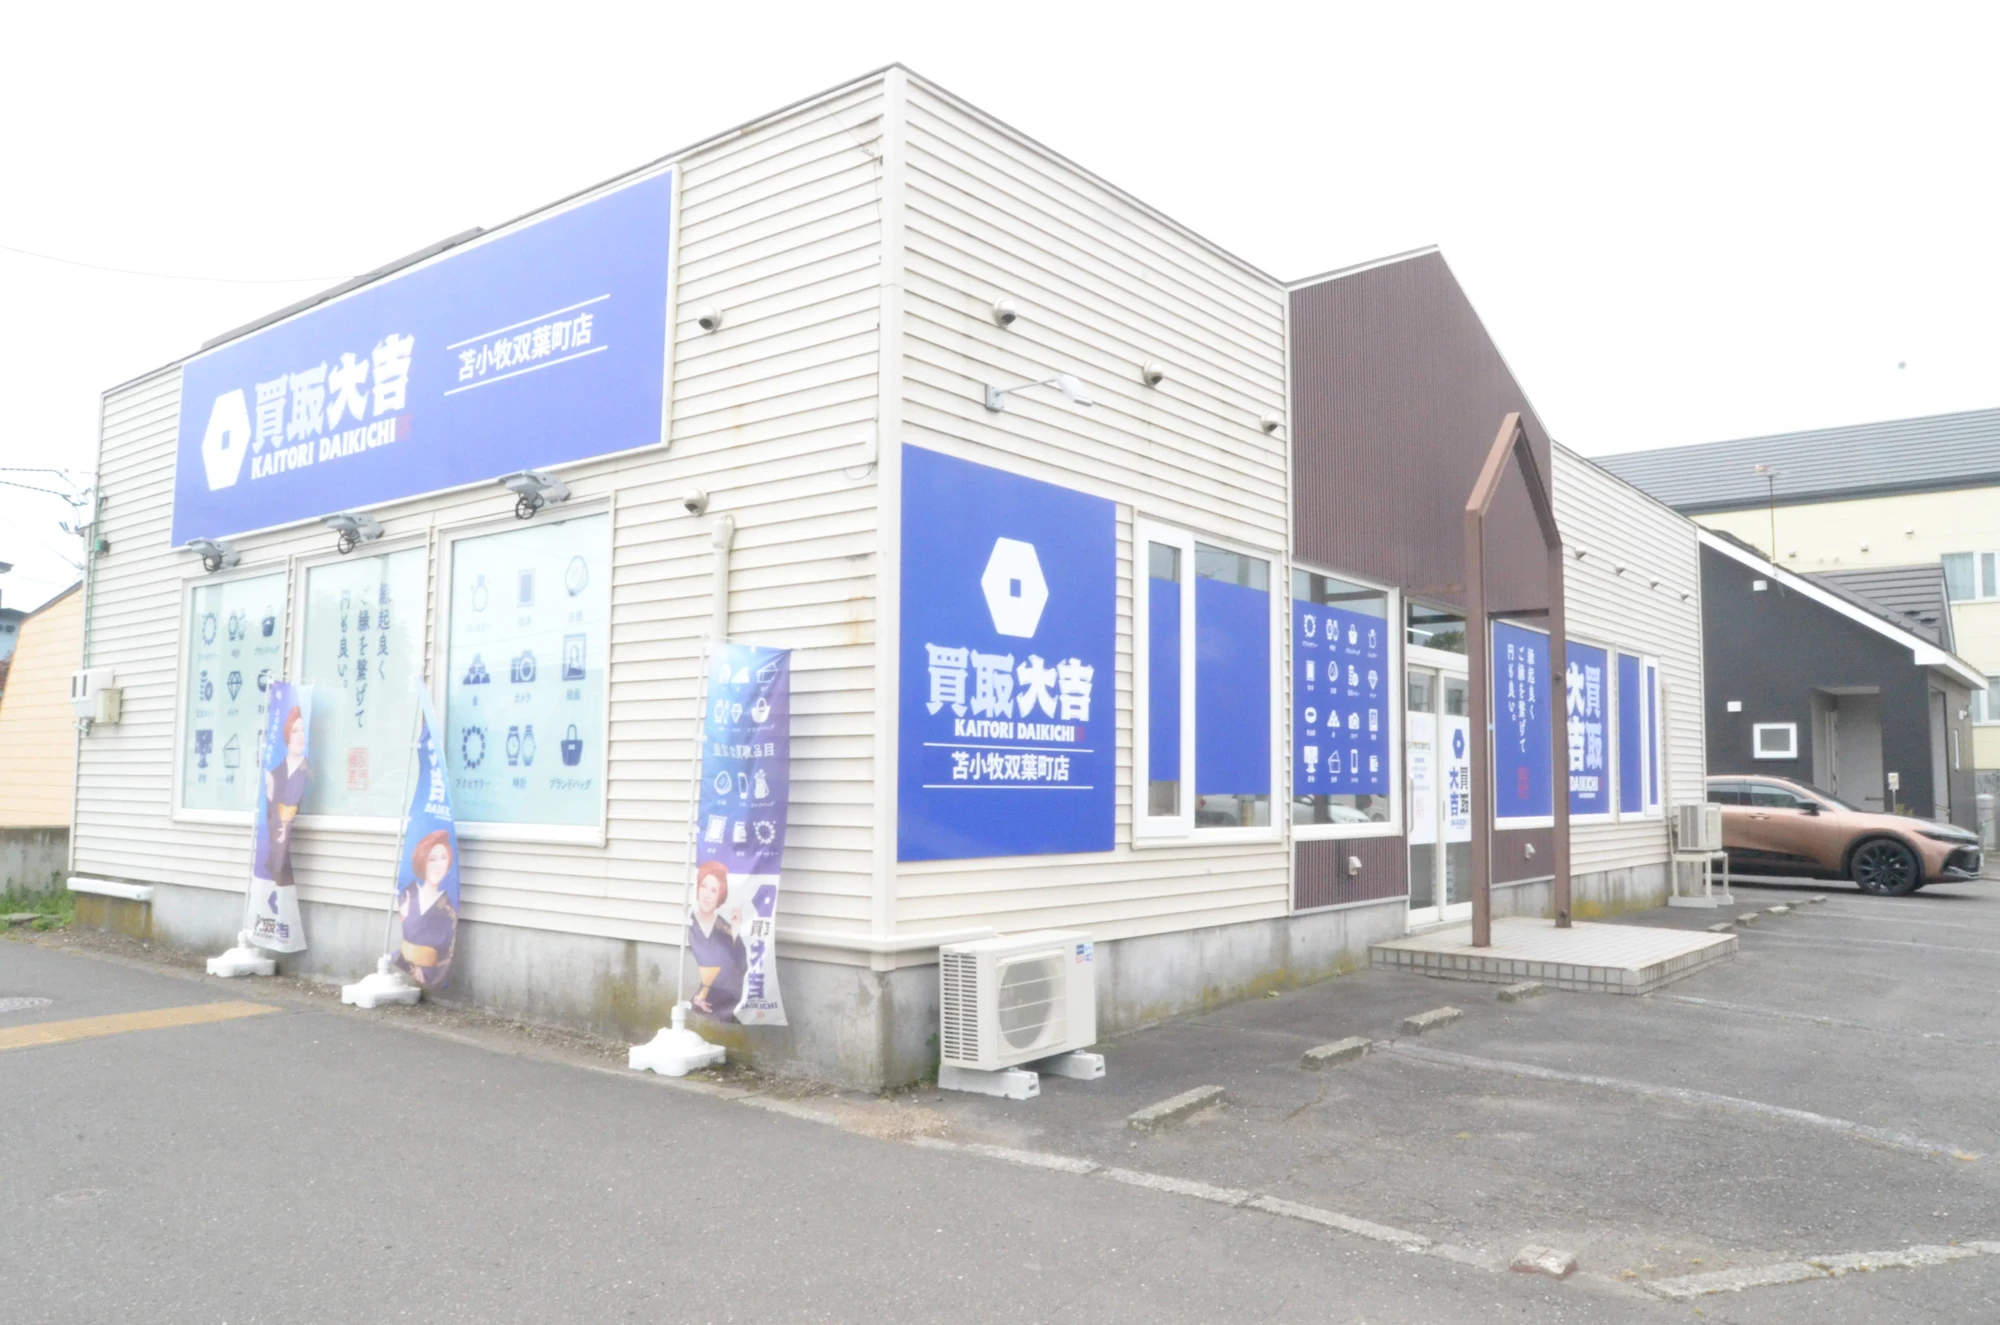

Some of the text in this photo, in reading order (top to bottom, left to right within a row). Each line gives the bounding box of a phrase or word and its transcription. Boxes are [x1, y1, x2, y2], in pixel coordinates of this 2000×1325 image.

[458, 313, 593, 382] 苫小牧双葉町店
[252, 333, 415, 454] 買取大吉
[251, 417, 397, 480] KAITORI DAIKICHI
[925, 642, 1094, 722] 買取大吉
[1566, 661, 1585, 772] 大吉
[954, 718, 1075, 743] KAITORI DAIKICHI
[951, 750, 1070, 781] 苫小牧双葉町店
